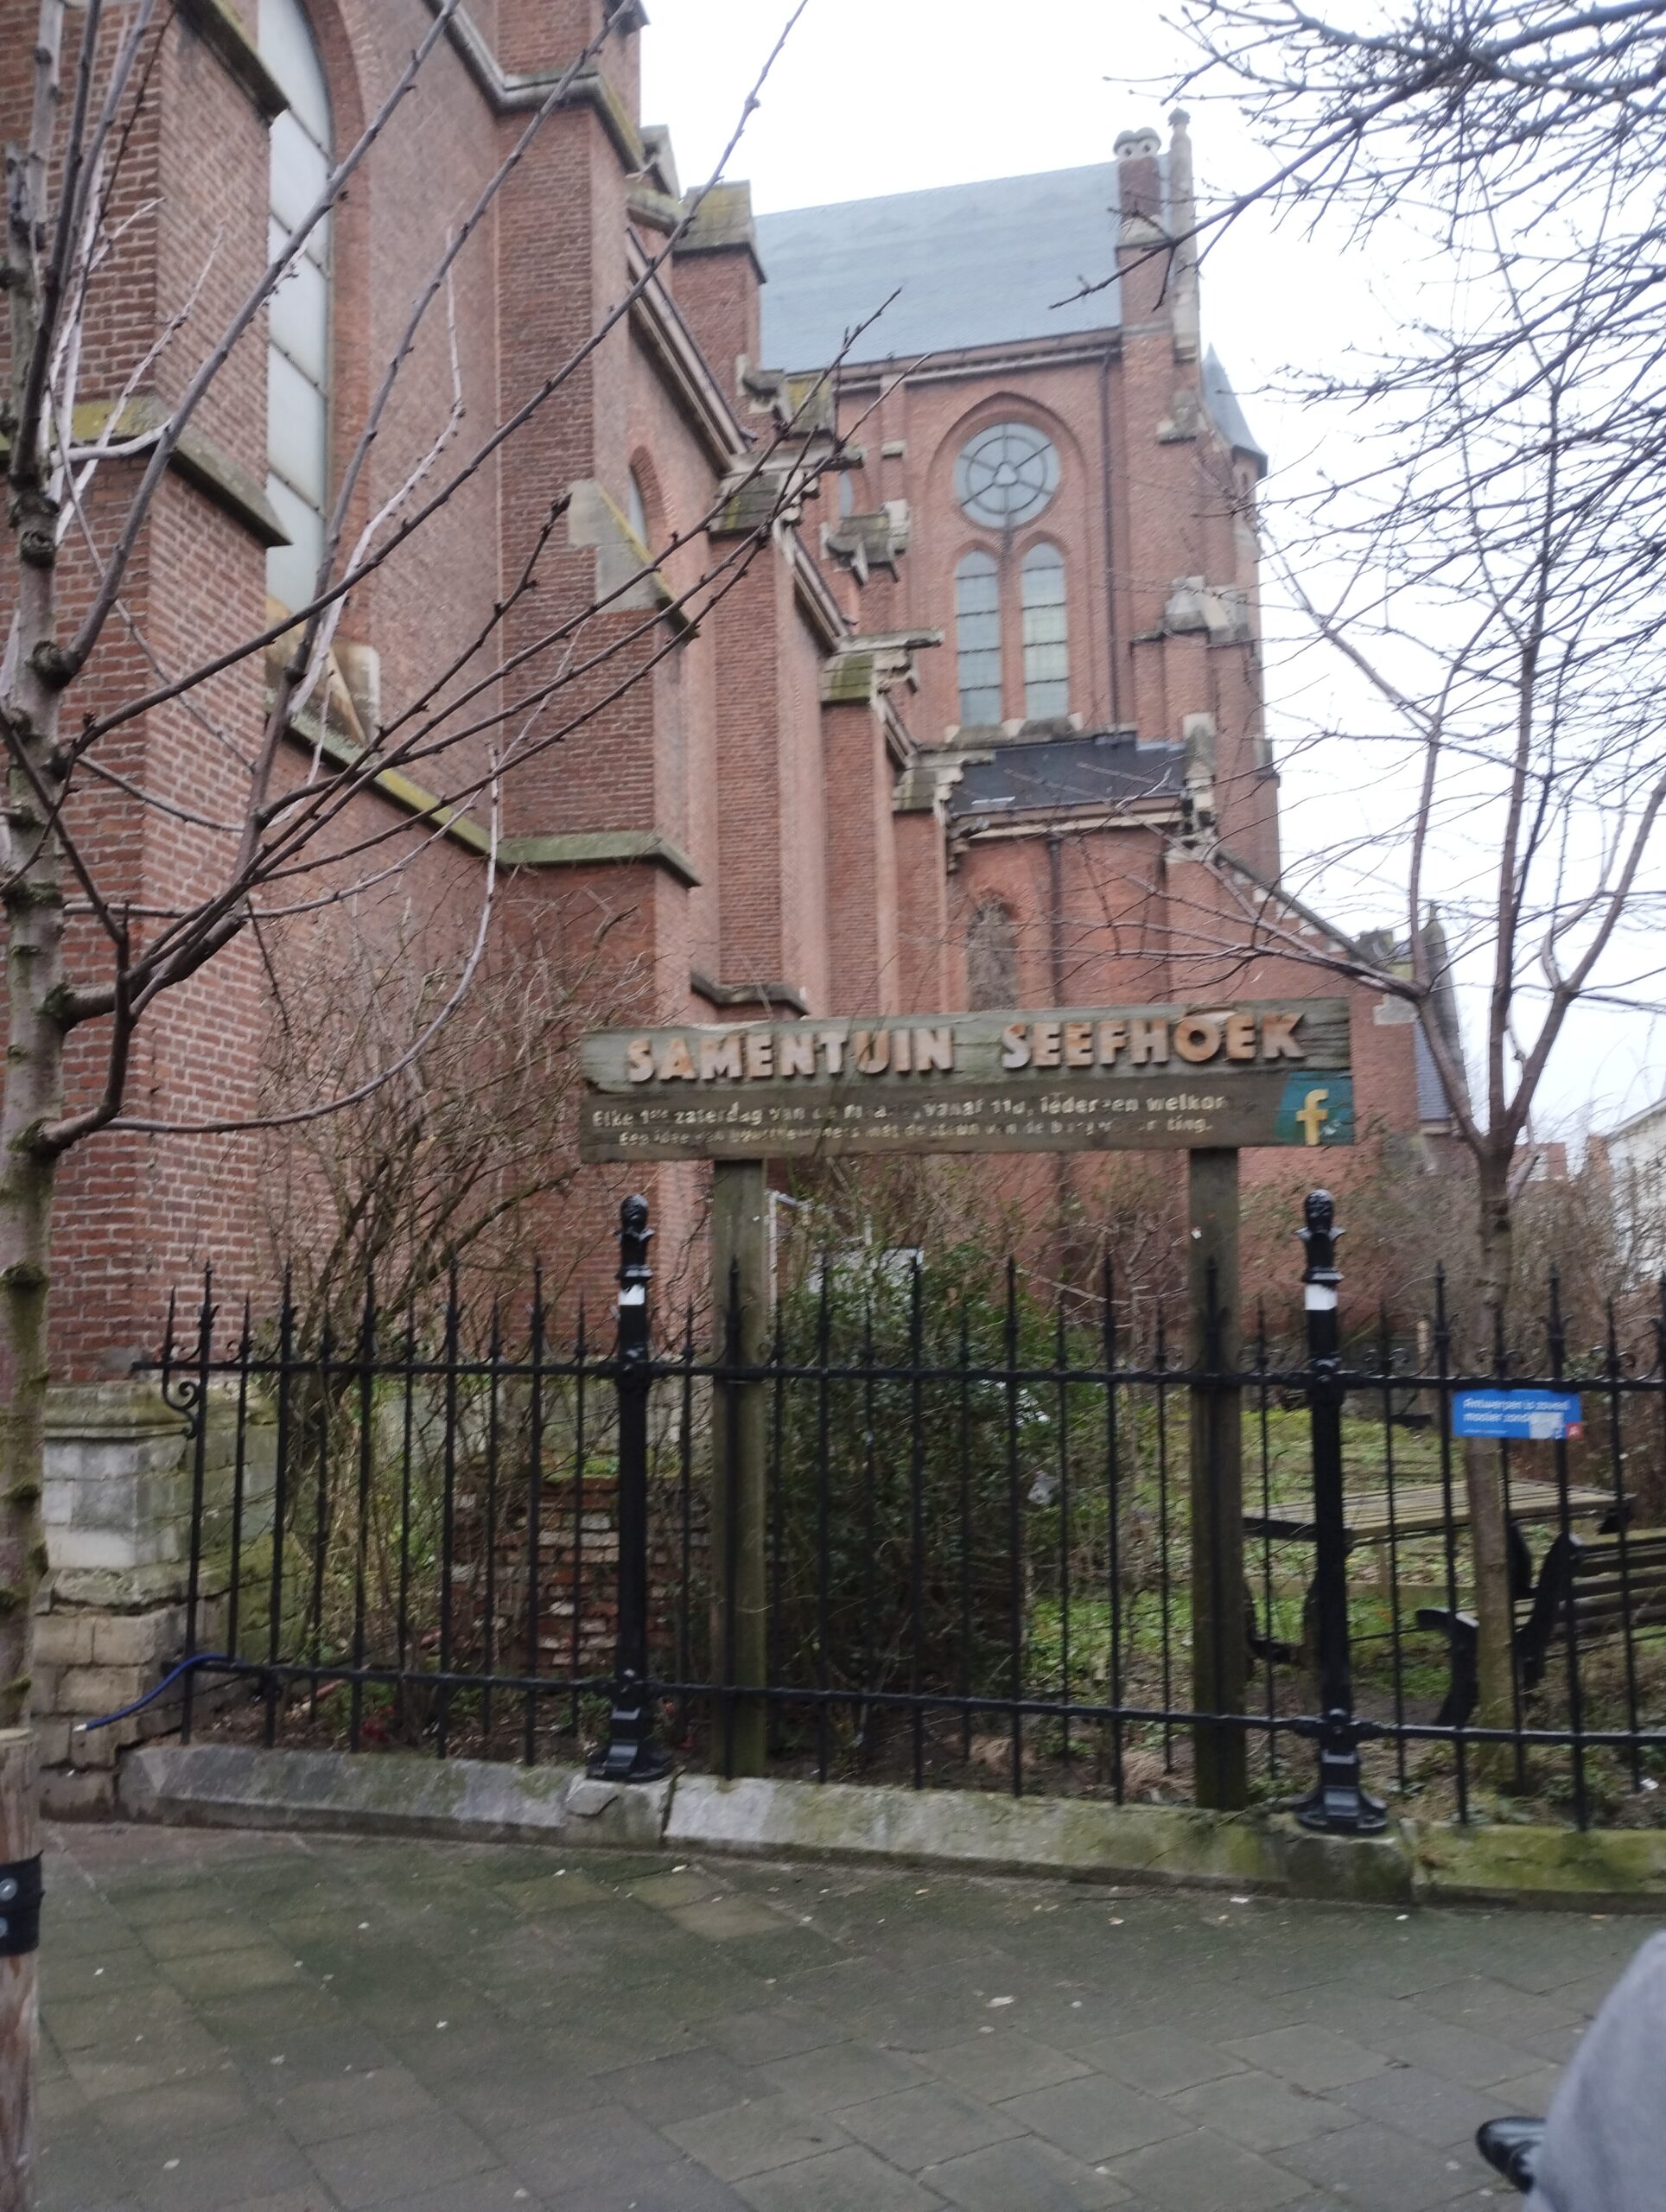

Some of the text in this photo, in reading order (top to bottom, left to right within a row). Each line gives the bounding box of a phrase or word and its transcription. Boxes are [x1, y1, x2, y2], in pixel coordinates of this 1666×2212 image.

[628, 1012, 1306, 1083] SAMENTUIN SEEFHOEK
[592, 1109, 633, 1128] Elke
[674, 1100, 764, 1126] zaterdag
[769, 1106, 805, 1122] van
[924, 1098, 985, 1118] vanaf
[1296, 1090, 1328, 1146] f
[619, 1130, 650, 1147] Een
